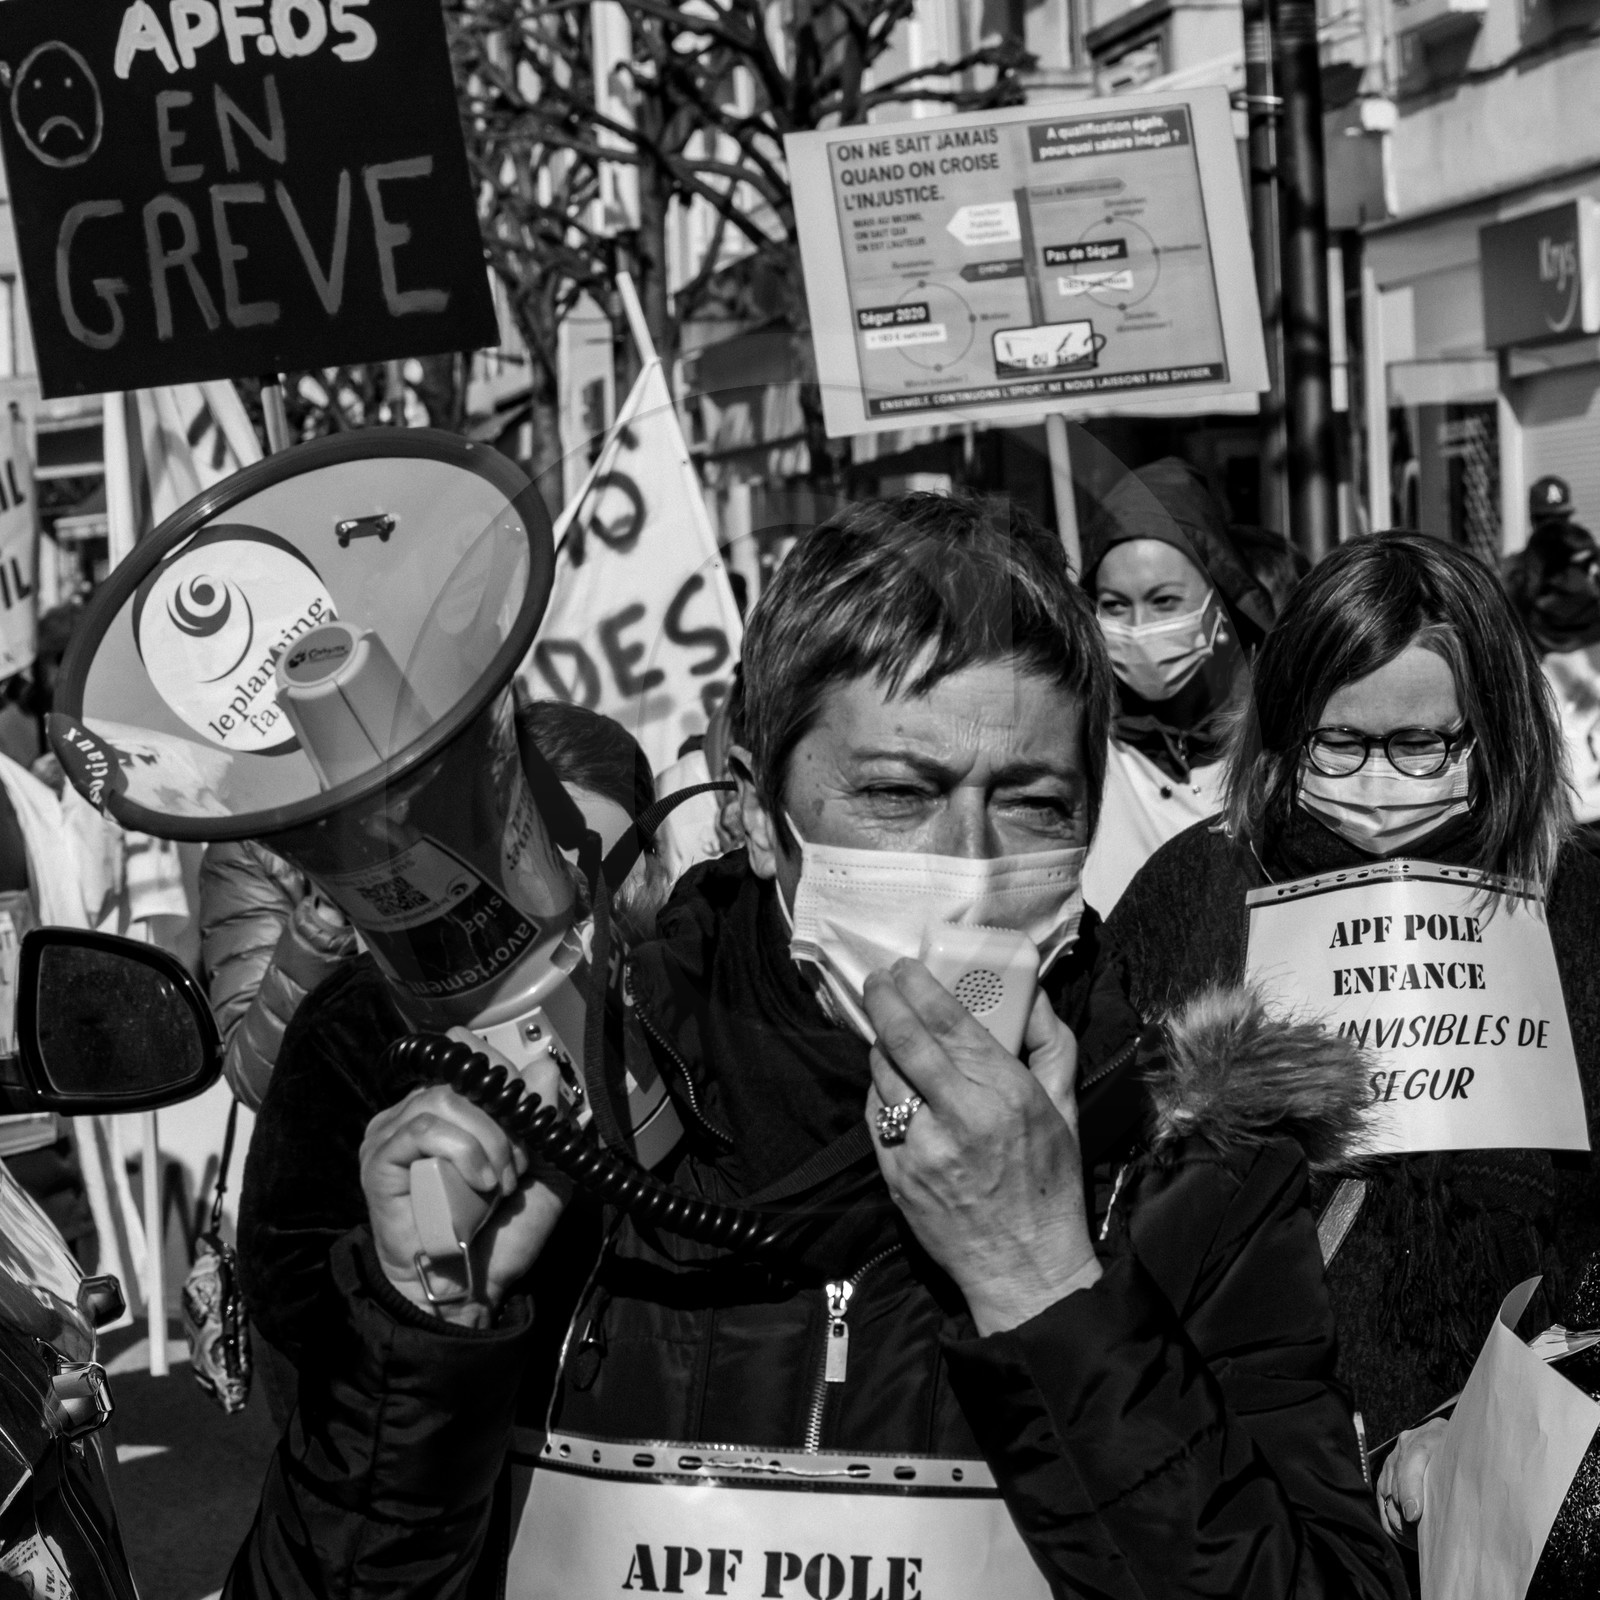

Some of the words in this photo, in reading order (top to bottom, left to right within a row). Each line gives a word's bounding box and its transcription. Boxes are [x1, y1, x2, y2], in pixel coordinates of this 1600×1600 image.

[156, 74, 286, 183] EN
[837, 143, 864, 162] ON
[868, 140, 891, 158] NE
[896, 135, 931, 155] SAIT
[936, 127, 999, 149] JAMAIS
[1046, 127, 1057, 140] A
[841, 164, 905, 187] QUAND
[908, 161, 935, 179] ON
[940, 153, 999, 174] CROISE
[845, 185, 945, 210] L'INJUSTICE.
[56, 156, 450, 349] GREVE
[1046, 248, 1068, 263] Pas
[1068, 247, 1085, 260] de
[1049, 381, 1064, 393] NE
[1064, 378, 1096, 392] NOUS
[1099, 373, 1147, 388] LAISSONS
[1149, 370, 1169, 382] PAS
[534, 574, 730, 714] DES
[463, 893, 503, 936] sida
[1329, 915, 1393, 950] APF
[1404, 913, 1483, 944] POLE
[1333, 962, 1487, 997] ENFANCE
[1337, 1013, 1510, 1051] INVISIBLES
[1518, 1017, 1550, 1049] DE
[1368, 1066, 1475, 1103] SEGUR
[621, 1543, 743, 1597] APF
[761, 1550, 923, 1600] POLE
